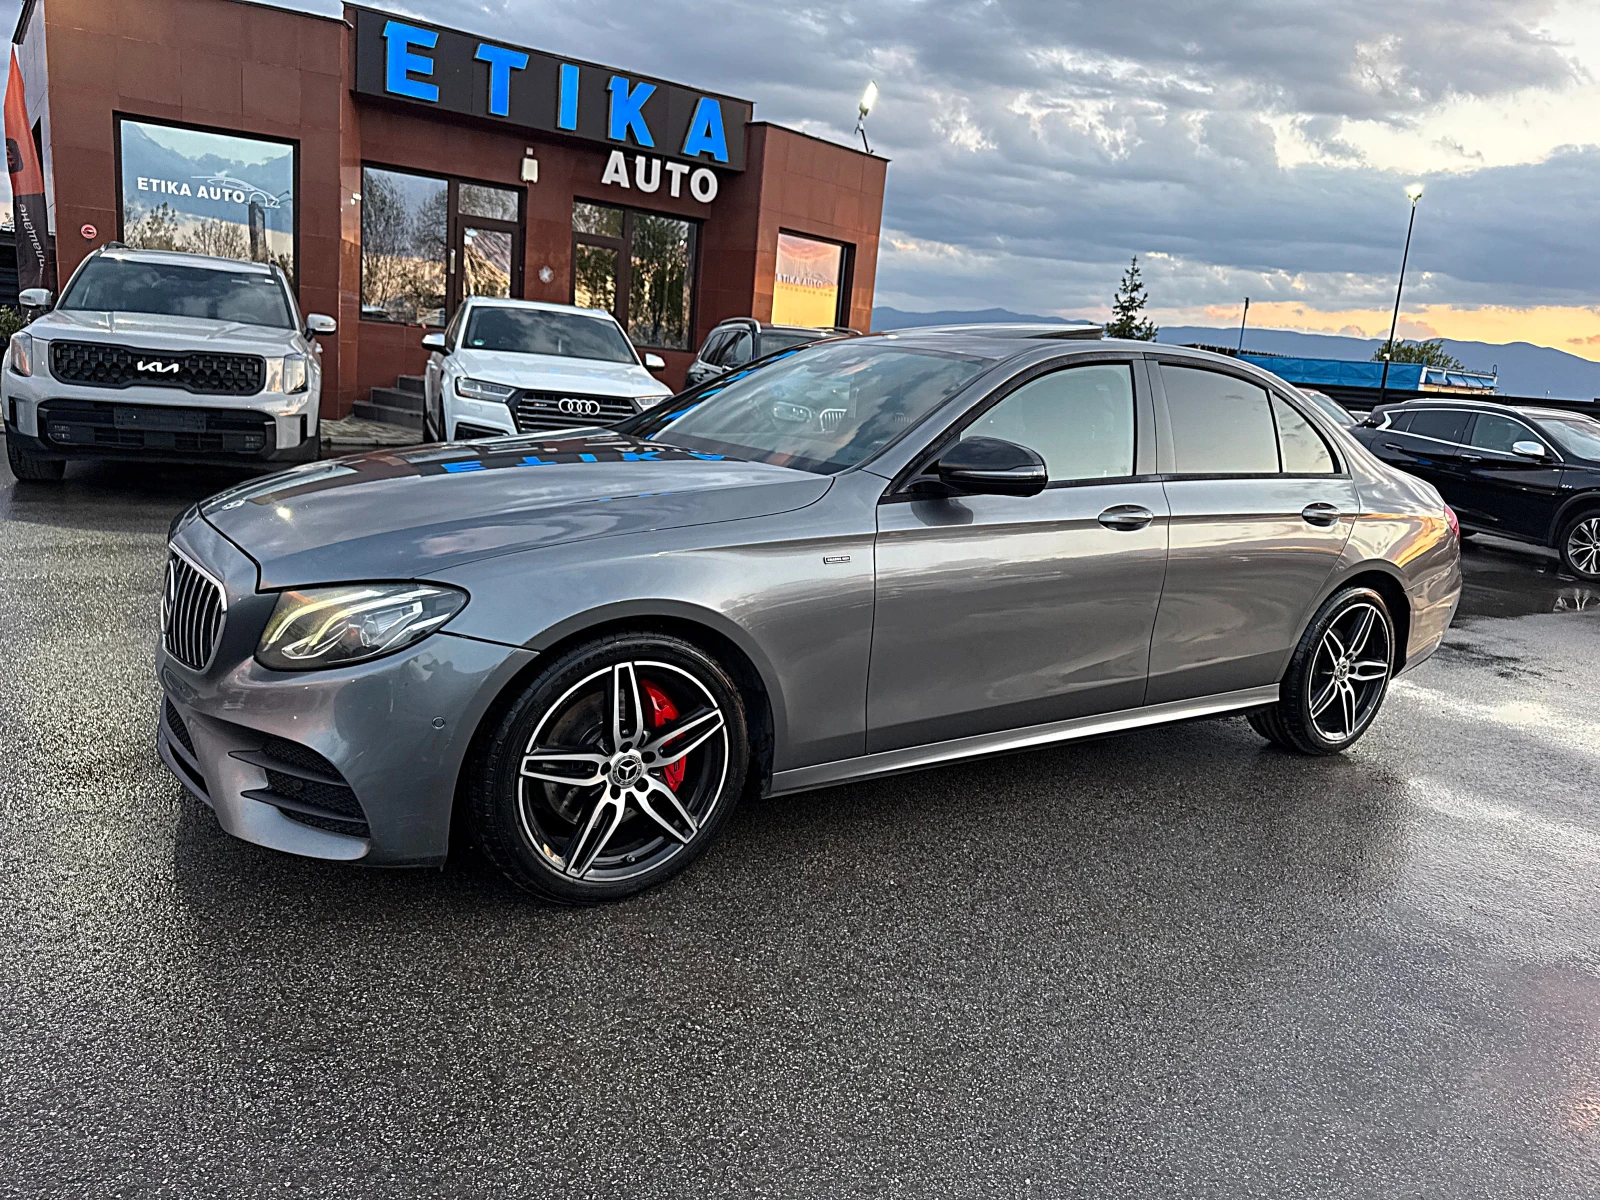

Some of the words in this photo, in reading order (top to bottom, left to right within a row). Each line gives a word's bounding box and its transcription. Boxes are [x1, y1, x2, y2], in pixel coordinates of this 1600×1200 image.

[383, 20, 729, 163] ETIKA
[137, 176, 192, 197] ETIKA
[196, 185, 246, 204] AUTO
[601, 150, 718, 203] AUTO
[801, 277, 823, 289] AUTO
